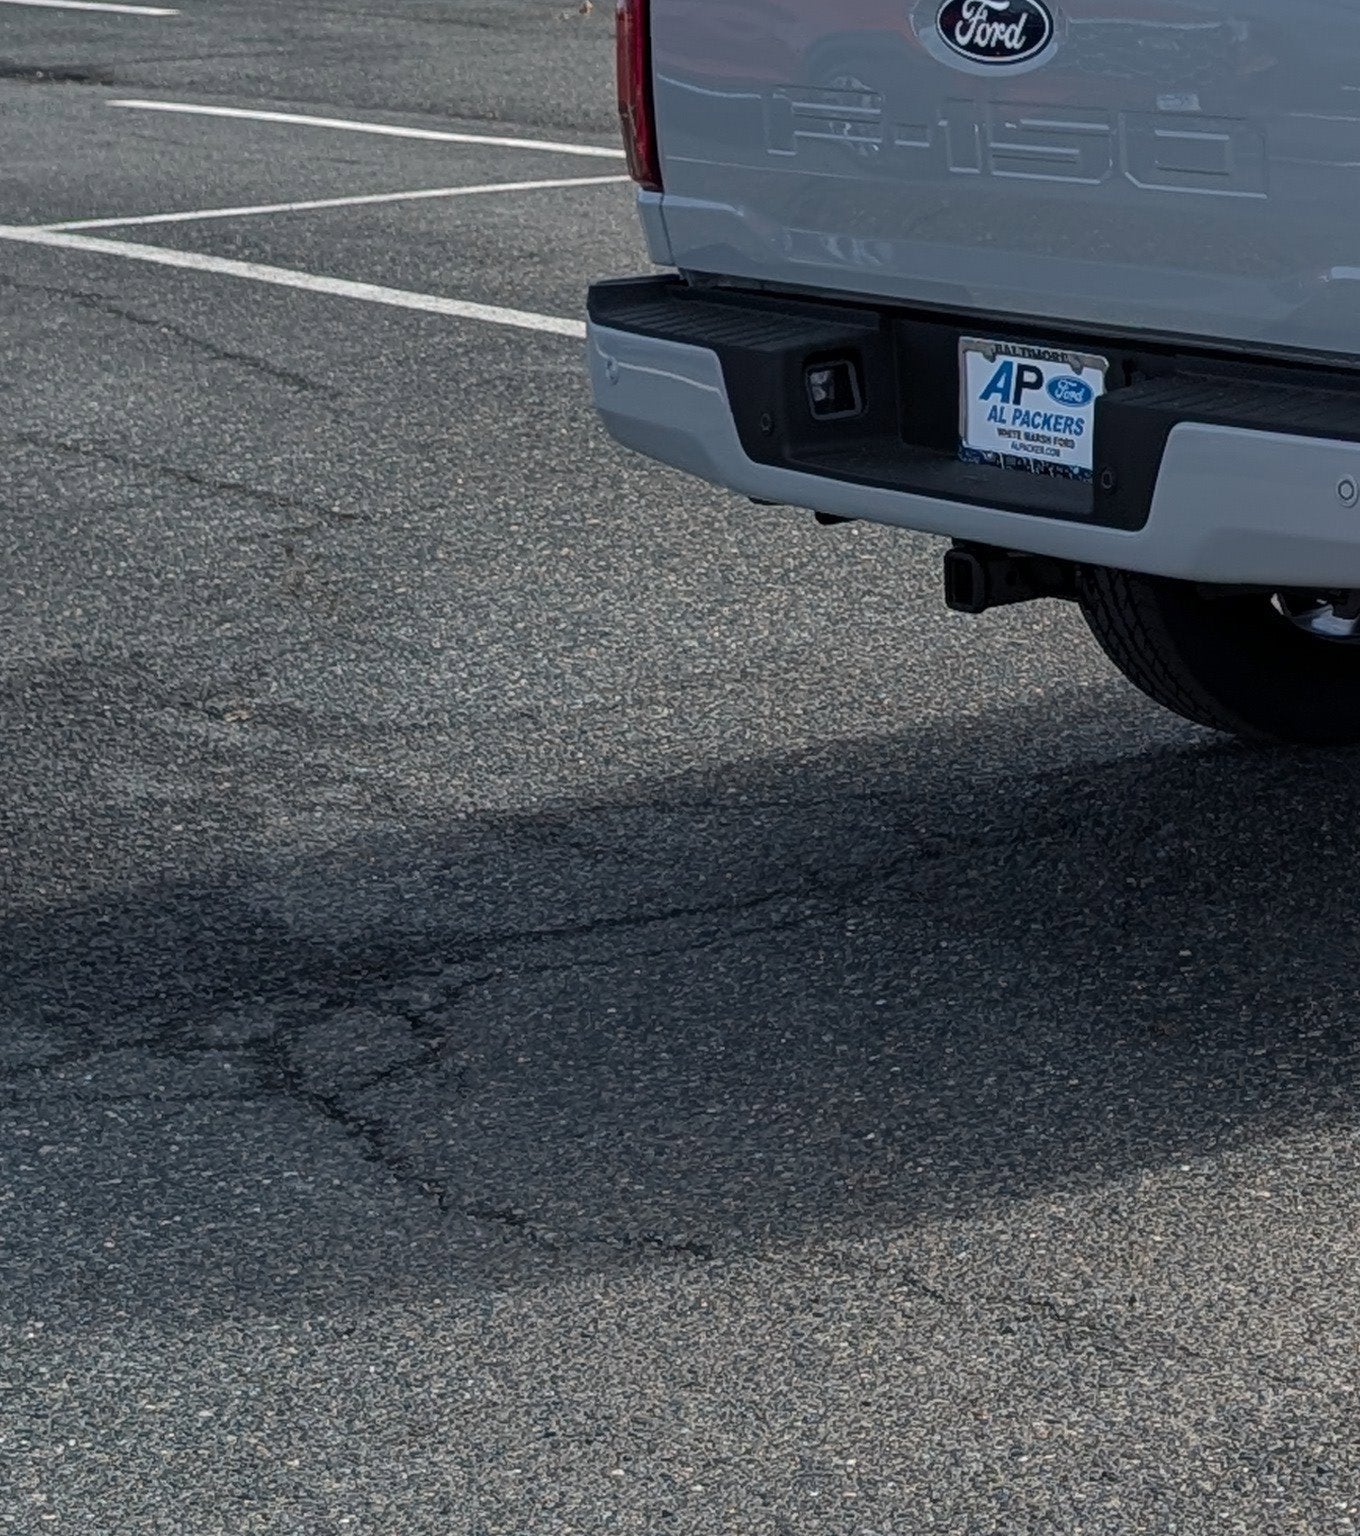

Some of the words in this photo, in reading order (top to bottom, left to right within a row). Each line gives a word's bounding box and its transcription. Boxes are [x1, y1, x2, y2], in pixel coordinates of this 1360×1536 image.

[979, 360, 1044, 405] AP
[1054, 377, 1085, 403] Ford
[987, 405, 1007, 424] AL
[1011, 408, 1086, 436] PACKERS
[1024, 430, 1051, 445] MARSH
[1053, 435, 1076, 449] FORD
